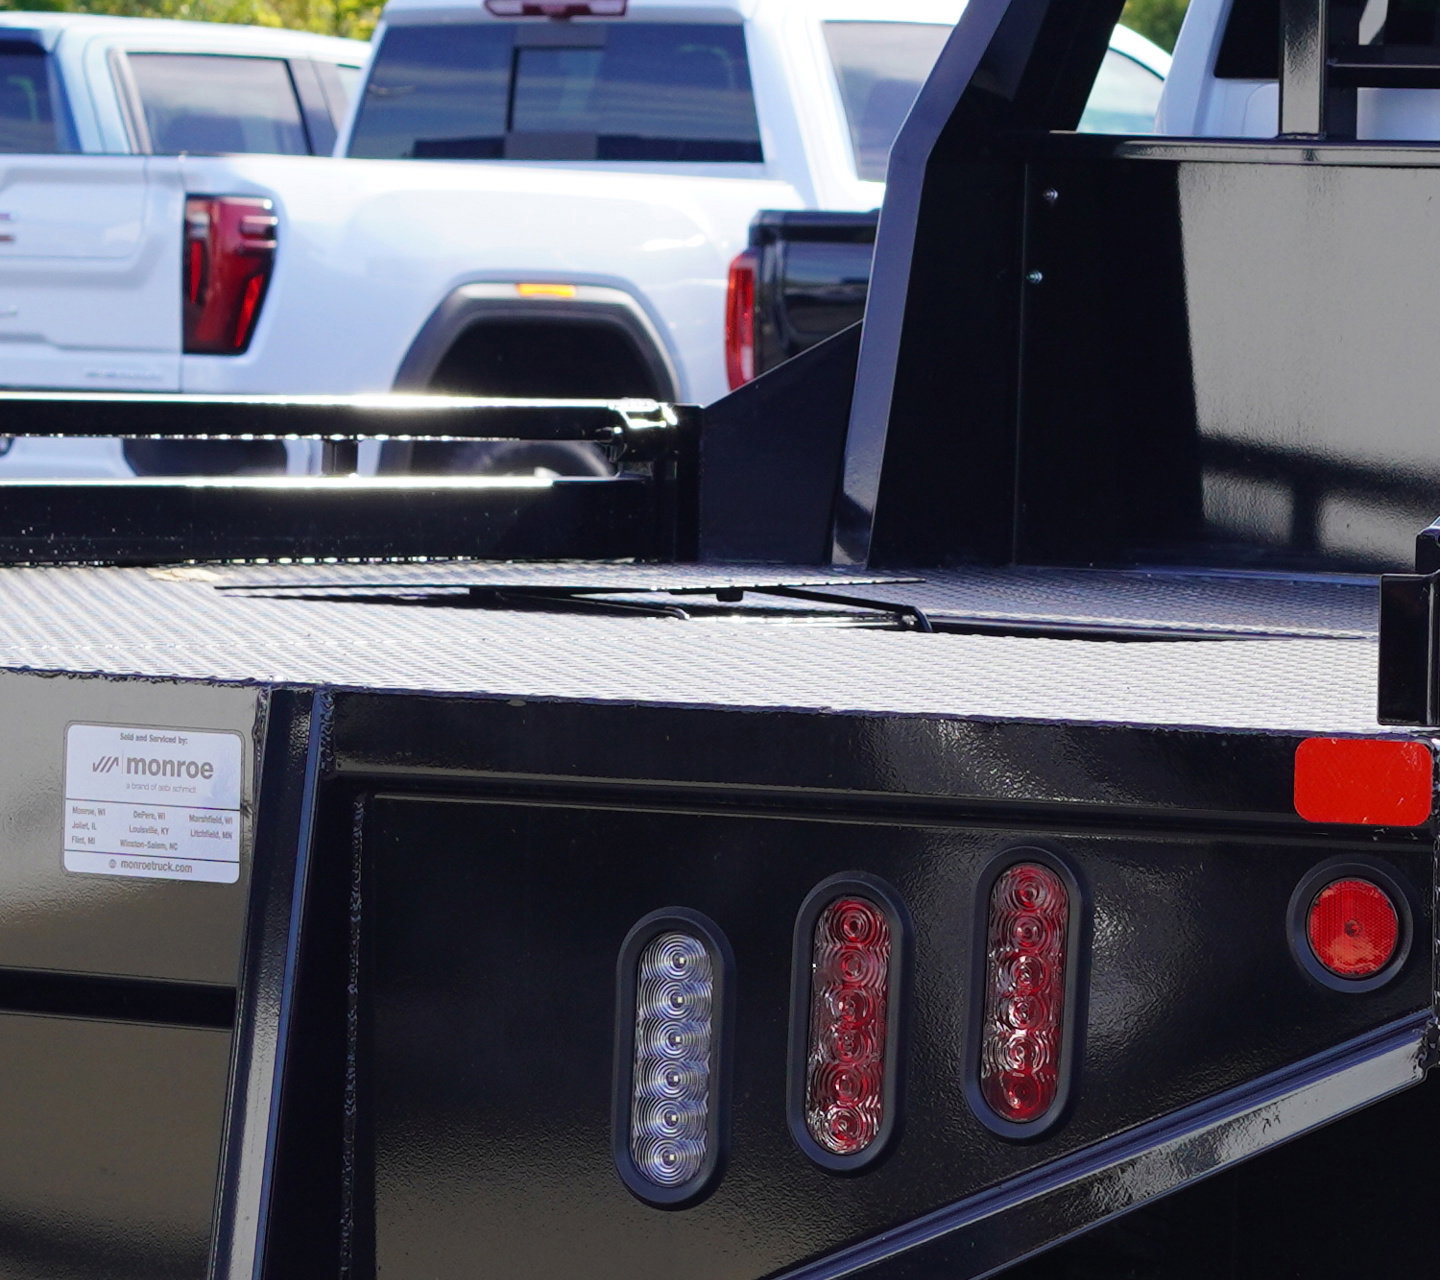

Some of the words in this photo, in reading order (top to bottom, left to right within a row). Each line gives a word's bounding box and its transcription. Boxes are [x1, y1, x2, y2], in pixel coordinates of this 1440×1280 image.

[120, 733, 134, 741] Sold
[136, 734, 147, 742] and
[149, 734, 176, 744] Serviced
[126, 756, 214, 779] monroe
[131, 782, 149, 791] brand
[161, 827, 169, 835] KY
[121, 860, 192, 873] monroetruck.com
